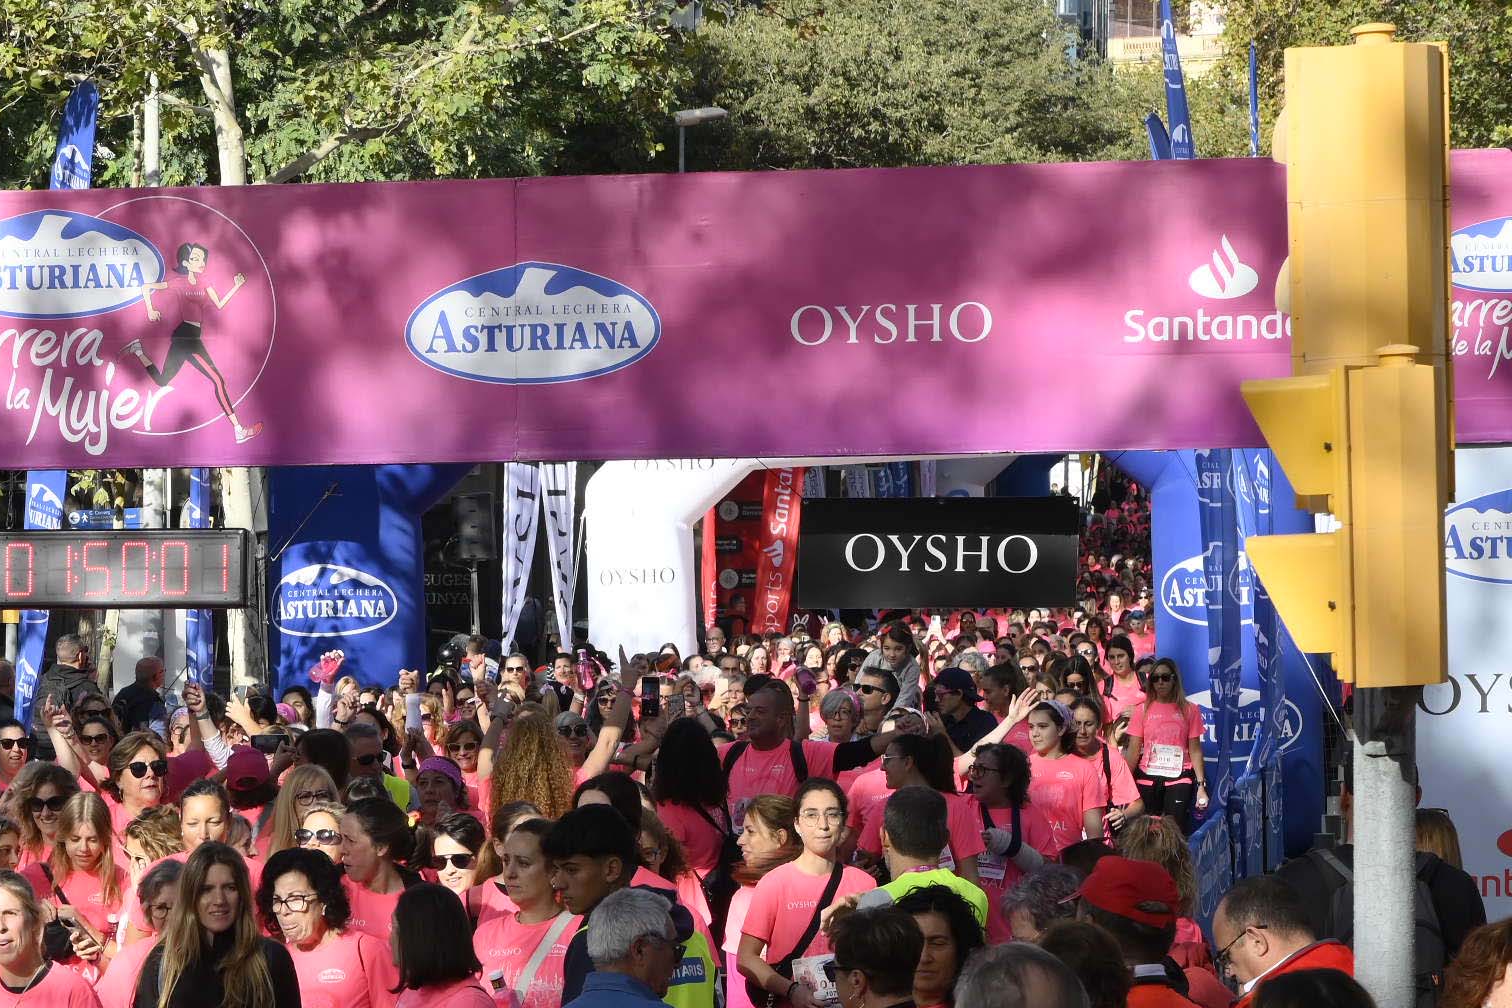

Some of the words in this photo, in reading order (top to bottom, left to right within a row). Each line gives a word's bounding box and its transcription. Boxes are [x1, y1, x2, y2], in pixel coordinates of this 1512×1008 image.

[66, 246, 140, 258] LECHERA
[464, 304, 543, 318] CENTRAL
[551, 302, 632, 317] LECHERA
[425, 310, 641, 354] ASTURIANA
[790, 301, 993, 346] OYSHO
[1123, 307, 1291, 343] Santand
[6, 370, 31, 410] la
[25, 362, 174, 455] Mujer
[844, 532, 1039, 574] OYSHO
[599, 567, 676, 585] OYSHO
[288, 588, 331, 598] CENTRAL
[335, 588, 384, 598] LECHERA
[276, 598, 388, 620] ASTURIANA
[787, 900, 817, 910] OYSHO
